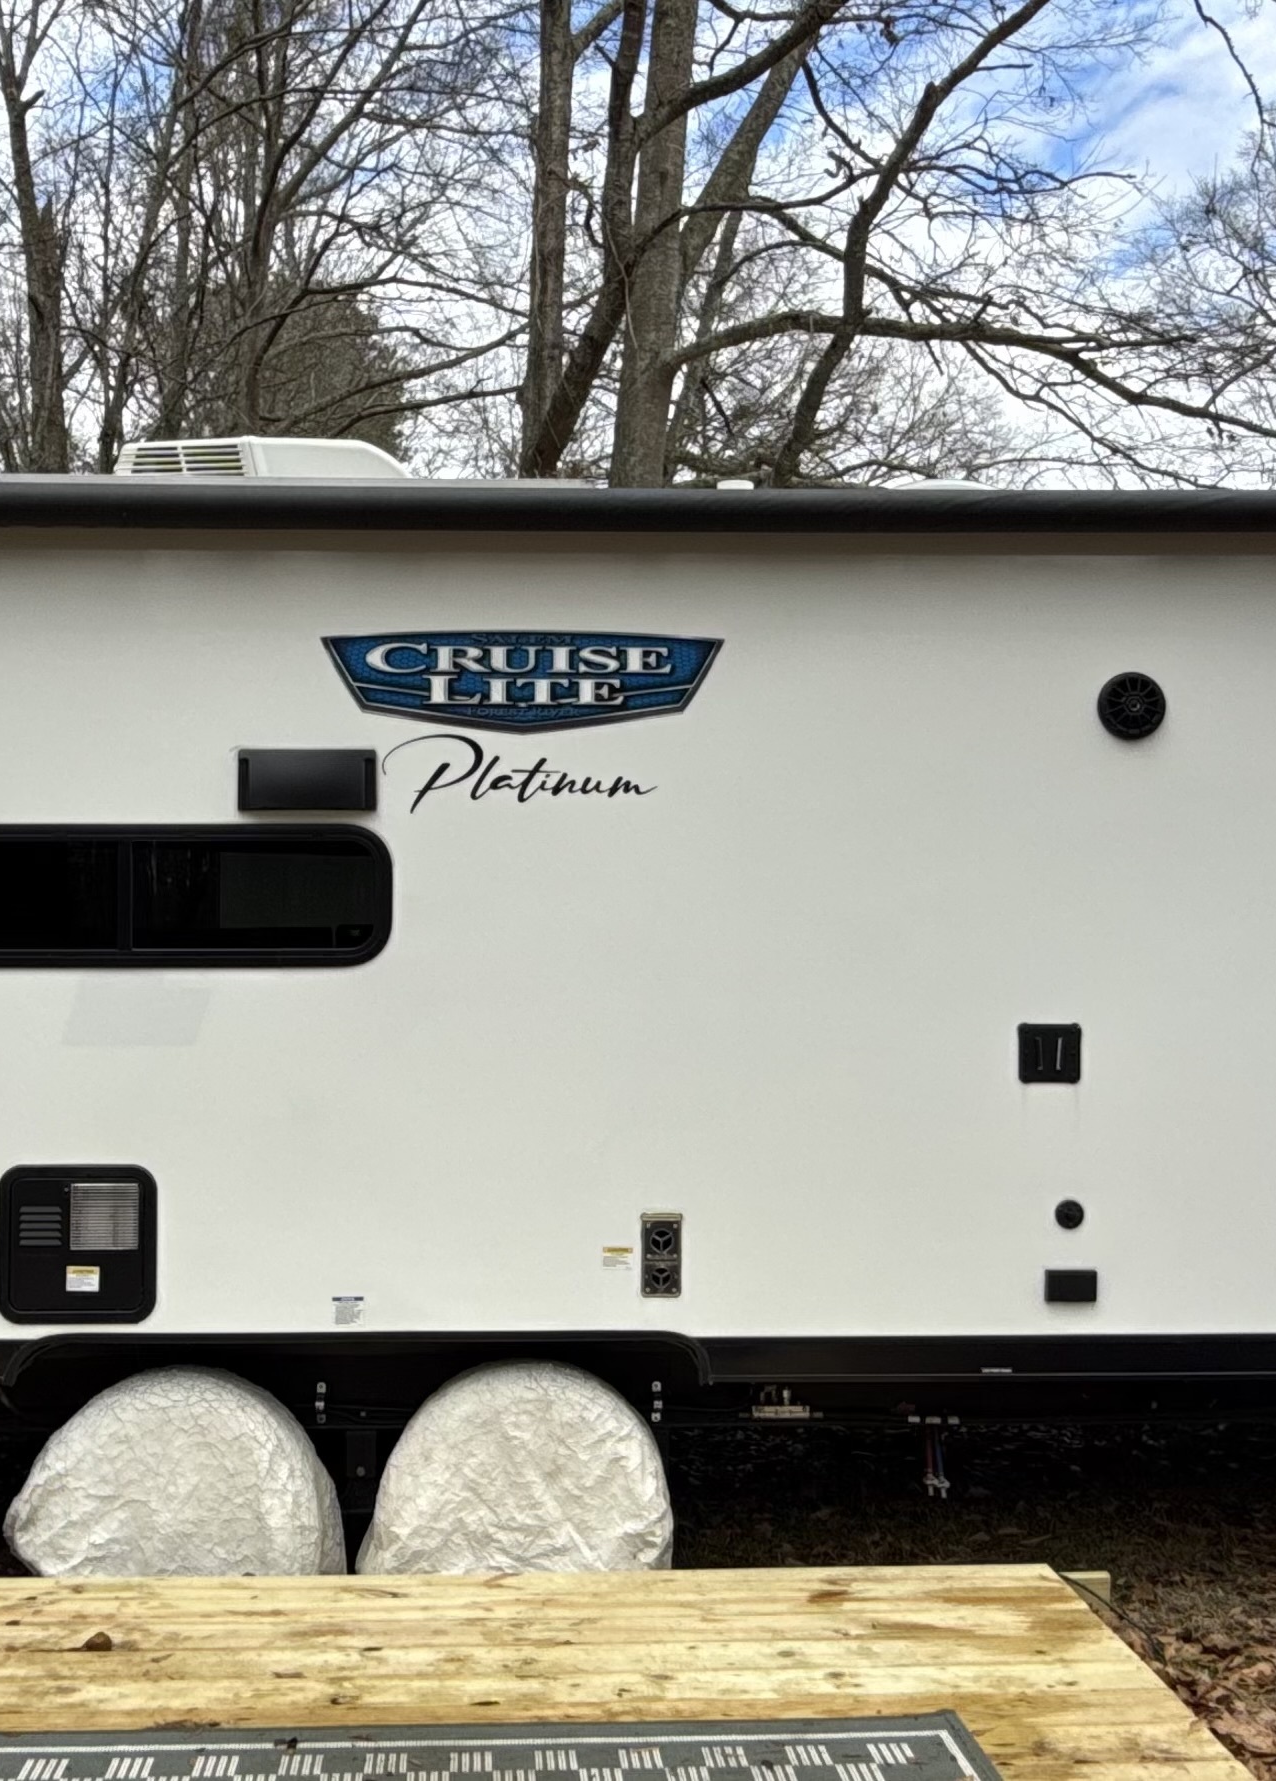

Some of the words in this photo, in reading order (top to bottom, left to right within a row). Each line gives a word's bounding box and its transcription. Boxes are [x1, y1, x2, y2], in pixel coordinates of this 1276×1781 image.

[365, 643, 671, 674] CRUISE
[424, 675, 624, 706] LITE
[382, 733, 658, 814] Platinum
